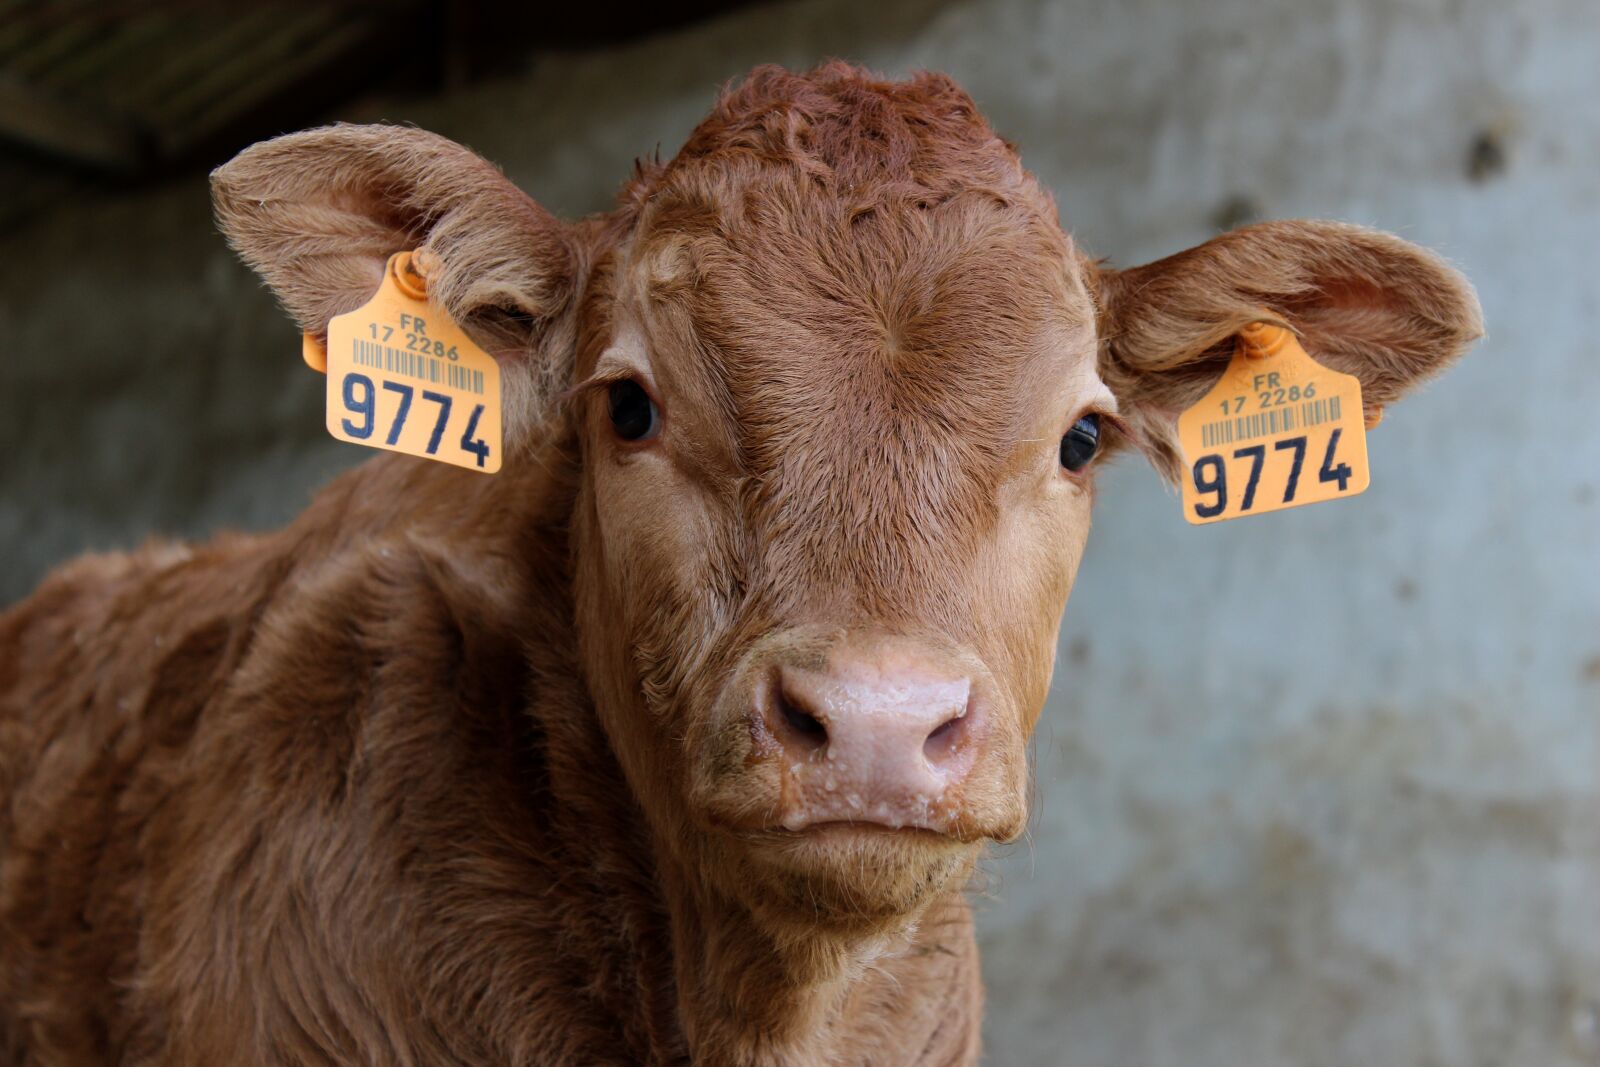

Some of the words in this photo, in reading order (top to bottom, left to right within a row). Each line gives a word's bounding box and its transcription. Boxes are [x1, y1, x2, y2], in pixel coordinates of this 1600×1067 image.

[369, 323, 394, 342] 17
[405, 333, 459, 361] 2286
[400, 313, 426, 335] FR
[1220, 396, 1247, 416] 17
[1259, 382, 1316, 409] 2286
[1254, 372, 1281, 392] FR
[341, 372, 490, 468] 9774
[1193, 428, 1353, 519] 9774
